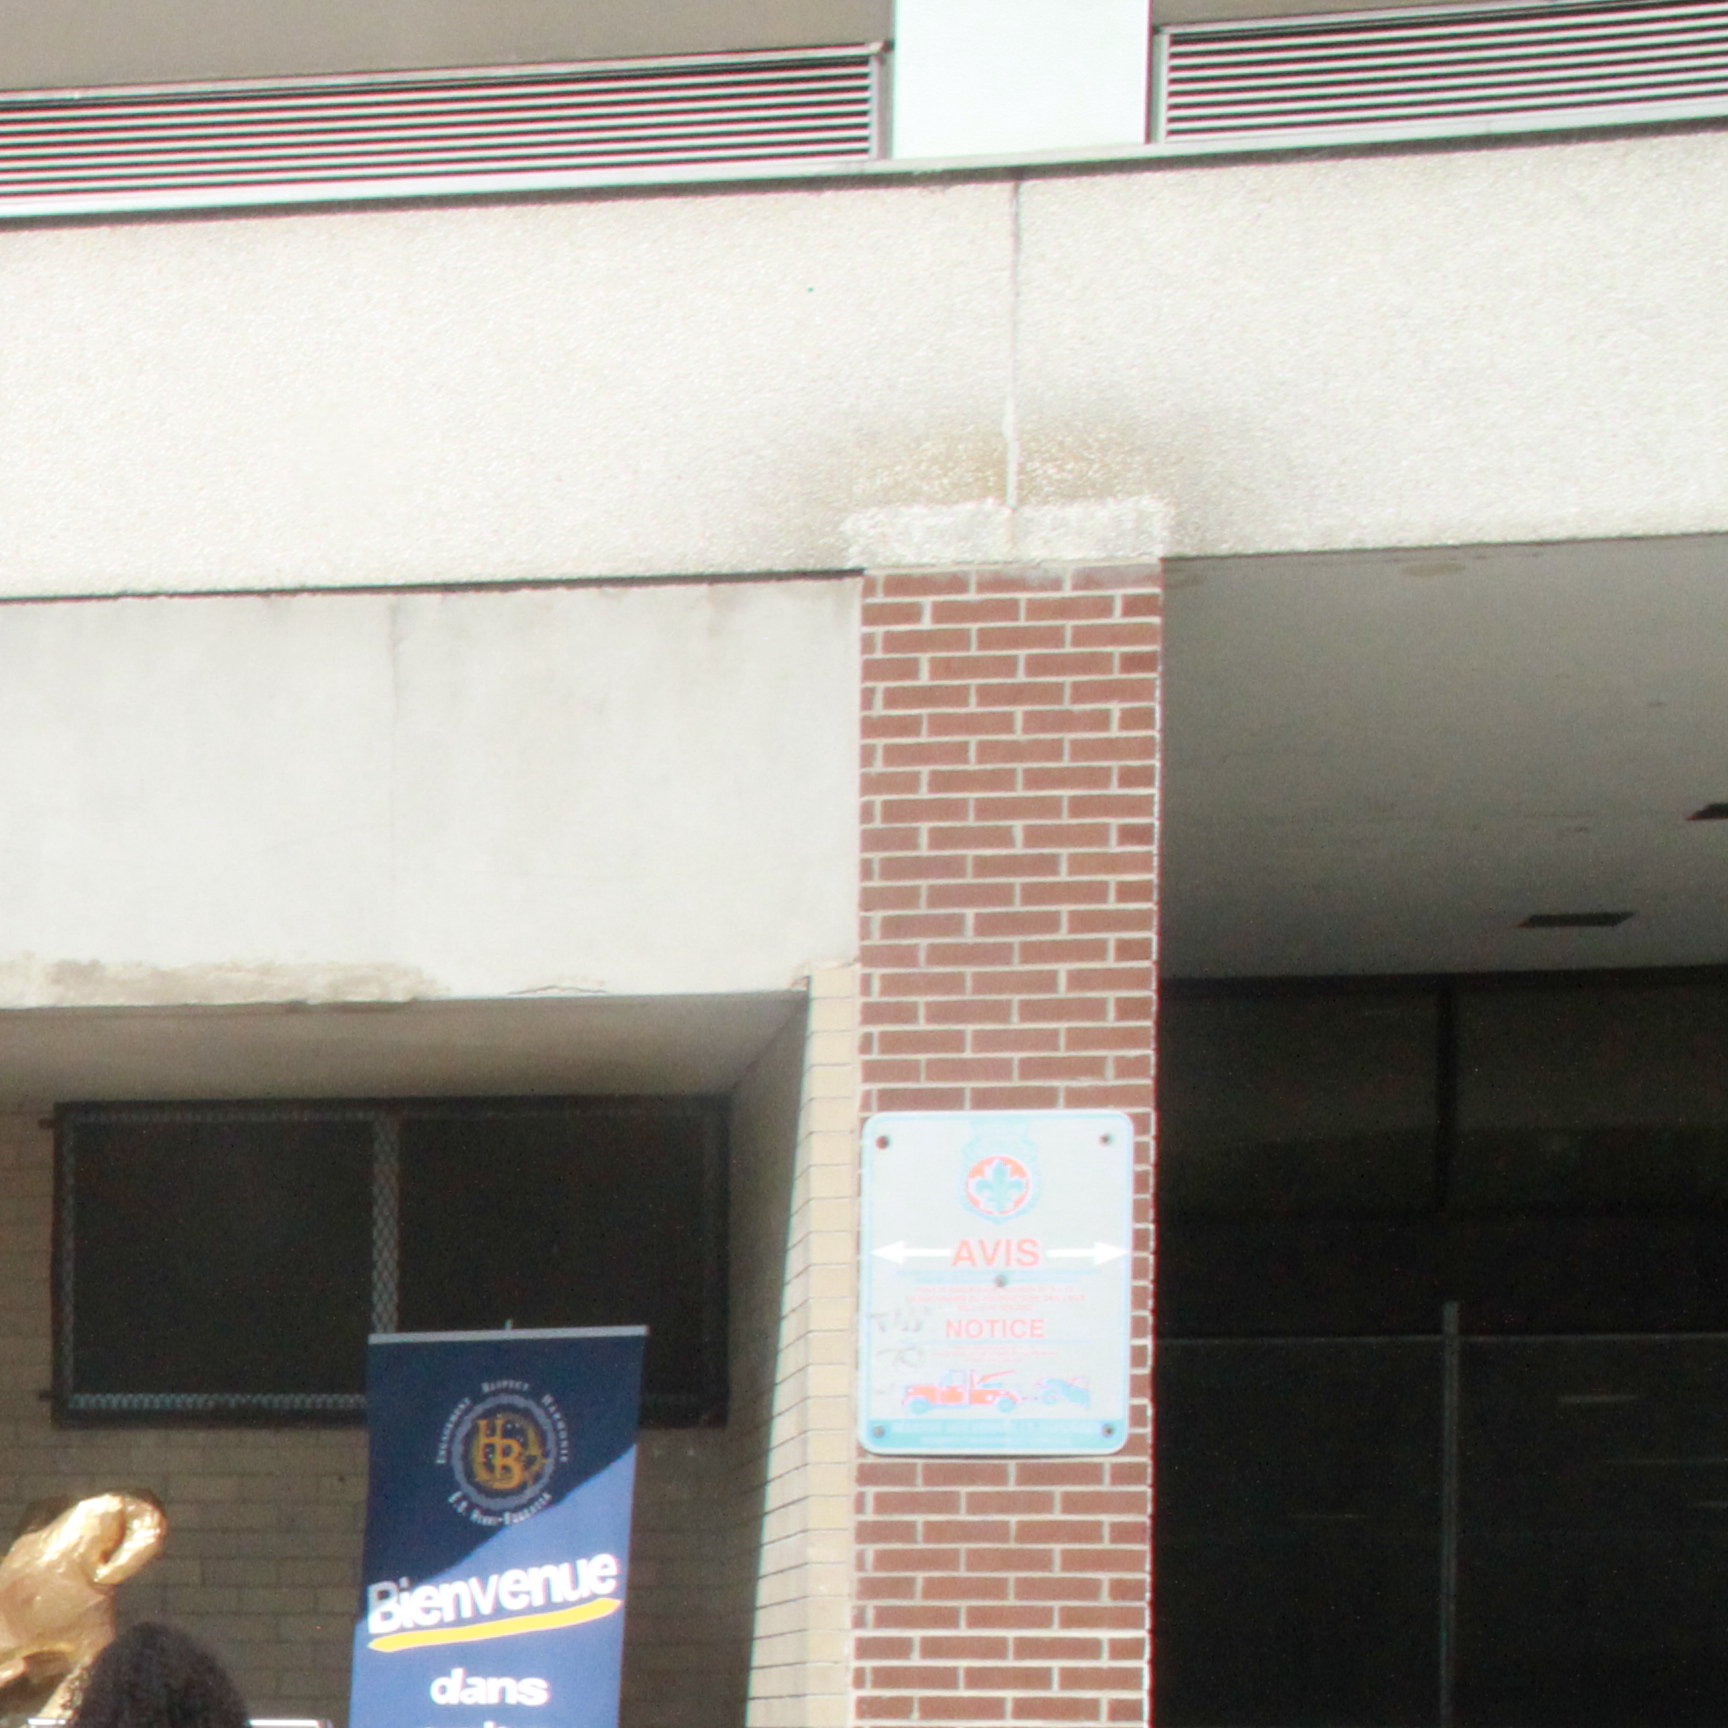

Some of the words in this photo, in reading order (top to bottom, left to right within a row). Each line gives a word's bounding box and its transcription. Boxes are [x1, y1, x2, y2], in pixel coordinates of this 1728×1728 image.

[951, 1238, 1041, 1268] AVIS
[945, 1318, 1045, 1339] NOTICE
[367, 1553, 620, 1635] Bienvenue
[429, 1667, 551, 1707] dans
